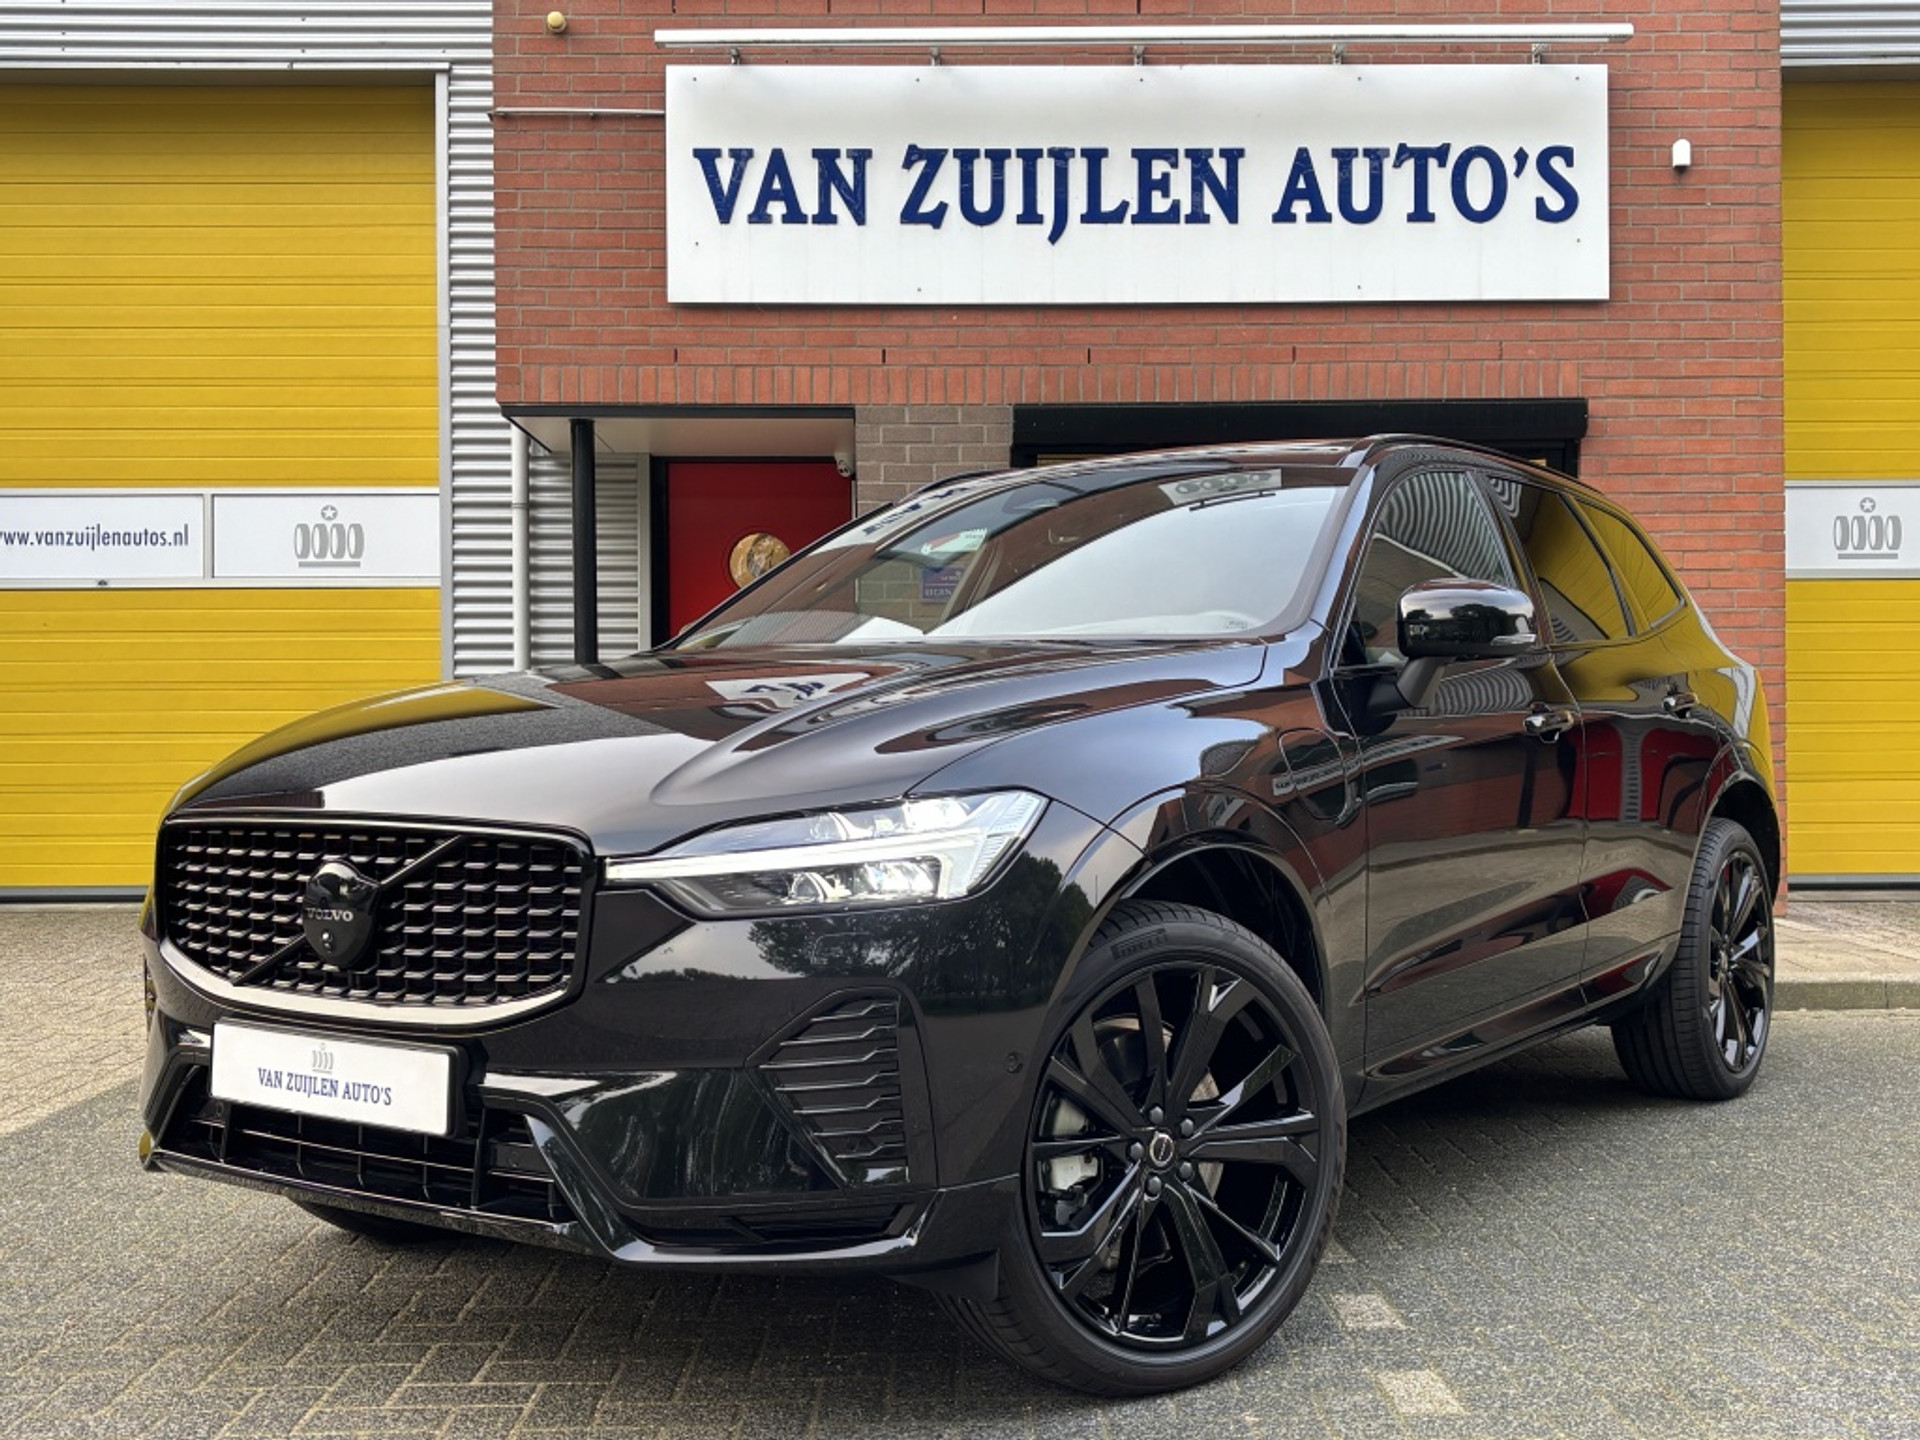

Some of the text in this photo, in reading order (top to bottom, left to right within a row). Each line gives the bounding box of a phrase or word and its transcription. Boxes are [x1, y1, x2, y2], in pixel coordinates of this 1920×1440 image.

[692, 142, 1580, 246] VAN ZUIJLEN AUTO'S
[0, 523, 190, 552] ww.vanzuijlenautos.nl
[305, 907, 354, 922] VOLVO
[257, 1067, 392, 1106] VAN ZUIJLEN AUTO'S
